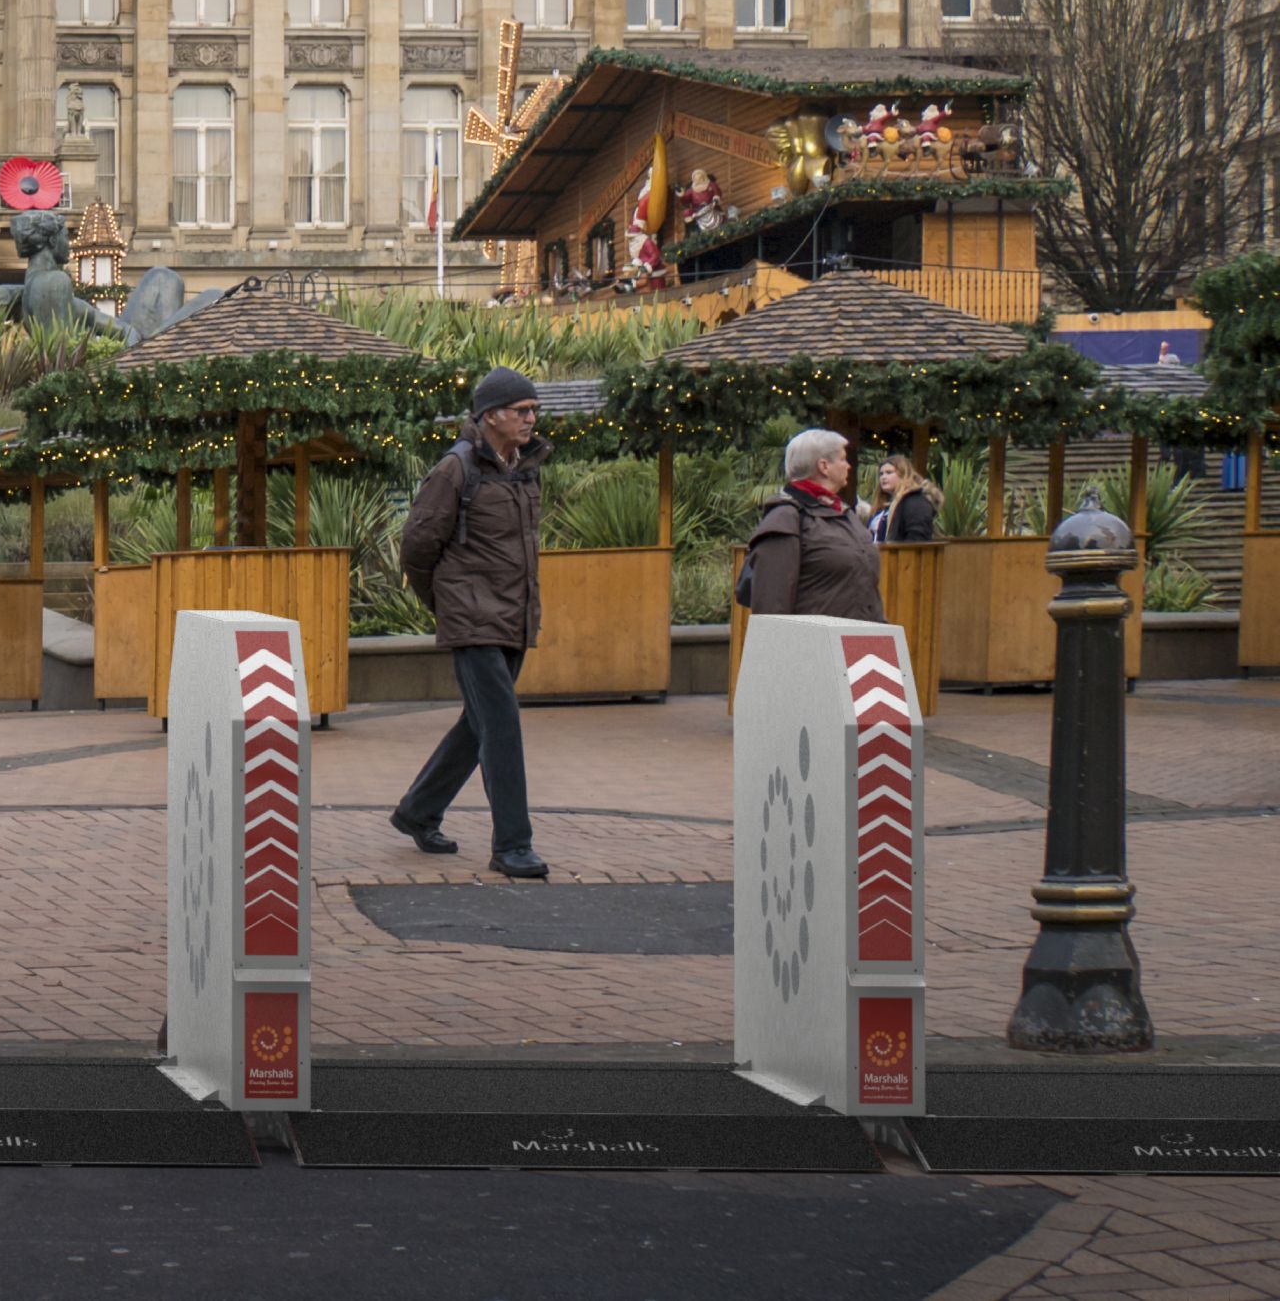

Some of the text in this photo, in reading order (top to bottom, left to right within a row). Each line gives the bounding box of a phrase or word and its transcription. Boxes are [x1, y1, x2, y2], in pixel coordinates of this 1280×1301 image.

[249, 1068, 294, 1079] Marshalls
[864, 1073, 909, 1084] Marshalls
[512, 1141, 659, 1152] Marshalls
